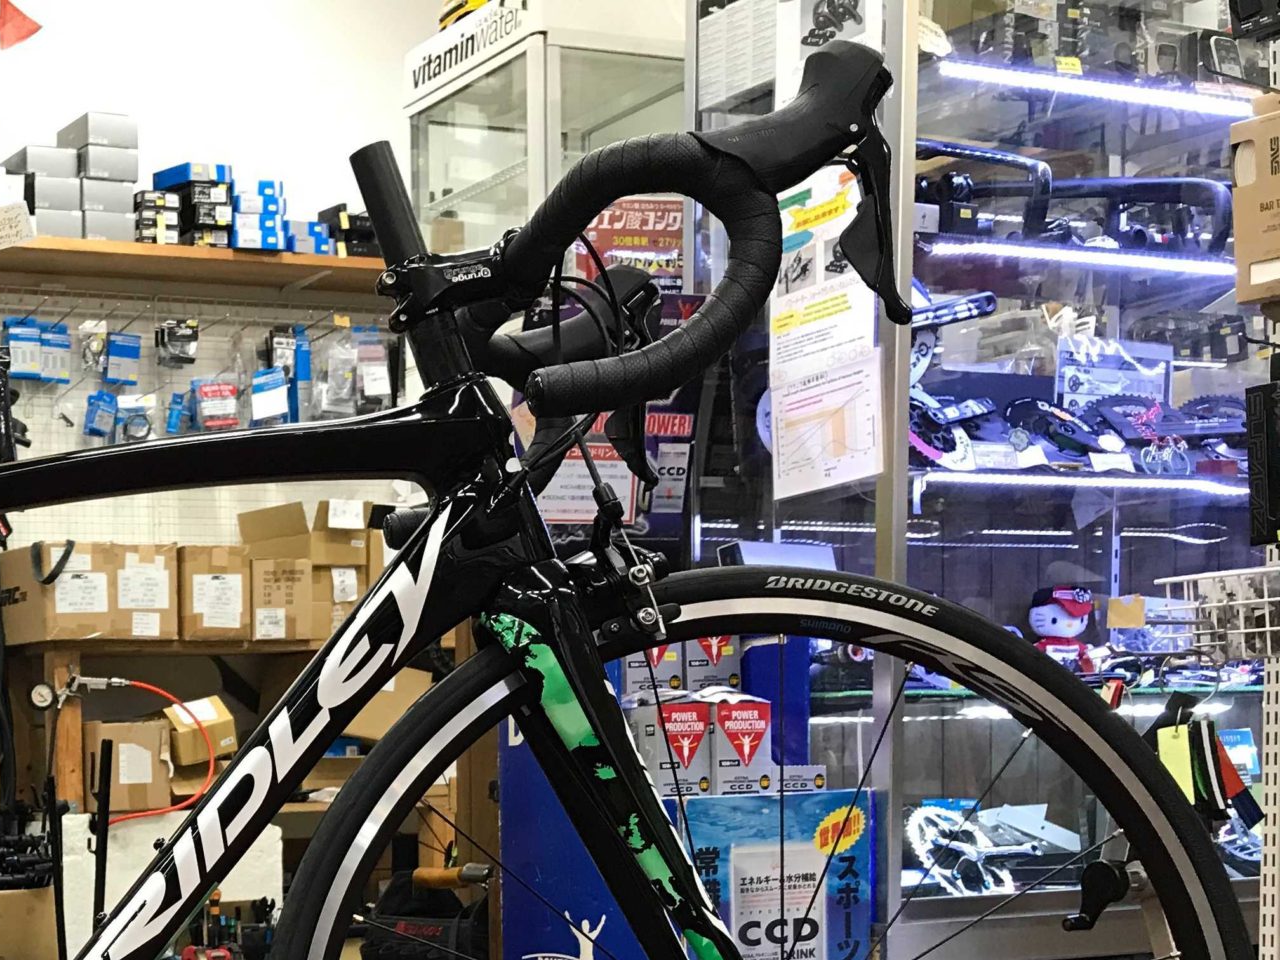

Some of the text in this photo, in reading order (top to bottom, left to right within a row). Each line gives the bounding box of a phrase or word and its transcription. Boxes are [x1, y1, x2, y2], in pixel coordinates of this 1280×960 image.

[646, 413, 693, 436] OWER!
[658, 466, 686, 477] CCD
[764, 575, 941, 617] BRIDGESTONE
[800, 618, 852, 634] SHIMANO
[671, 711, 698, 722] POWER
[731, 710, 759, 721] POWER
[664, 721, 705, 732] PRODUCTION
[724, 720, 766, 732] PRODUCTION
[670, 785, 693, 793] CCD
[730, 783, 754, 791] CCD
[784, 781, 808, 789] CCD
[740, 872, 817, 887] エネルギー水分補給
[737, 916, 820, 947] CCD
